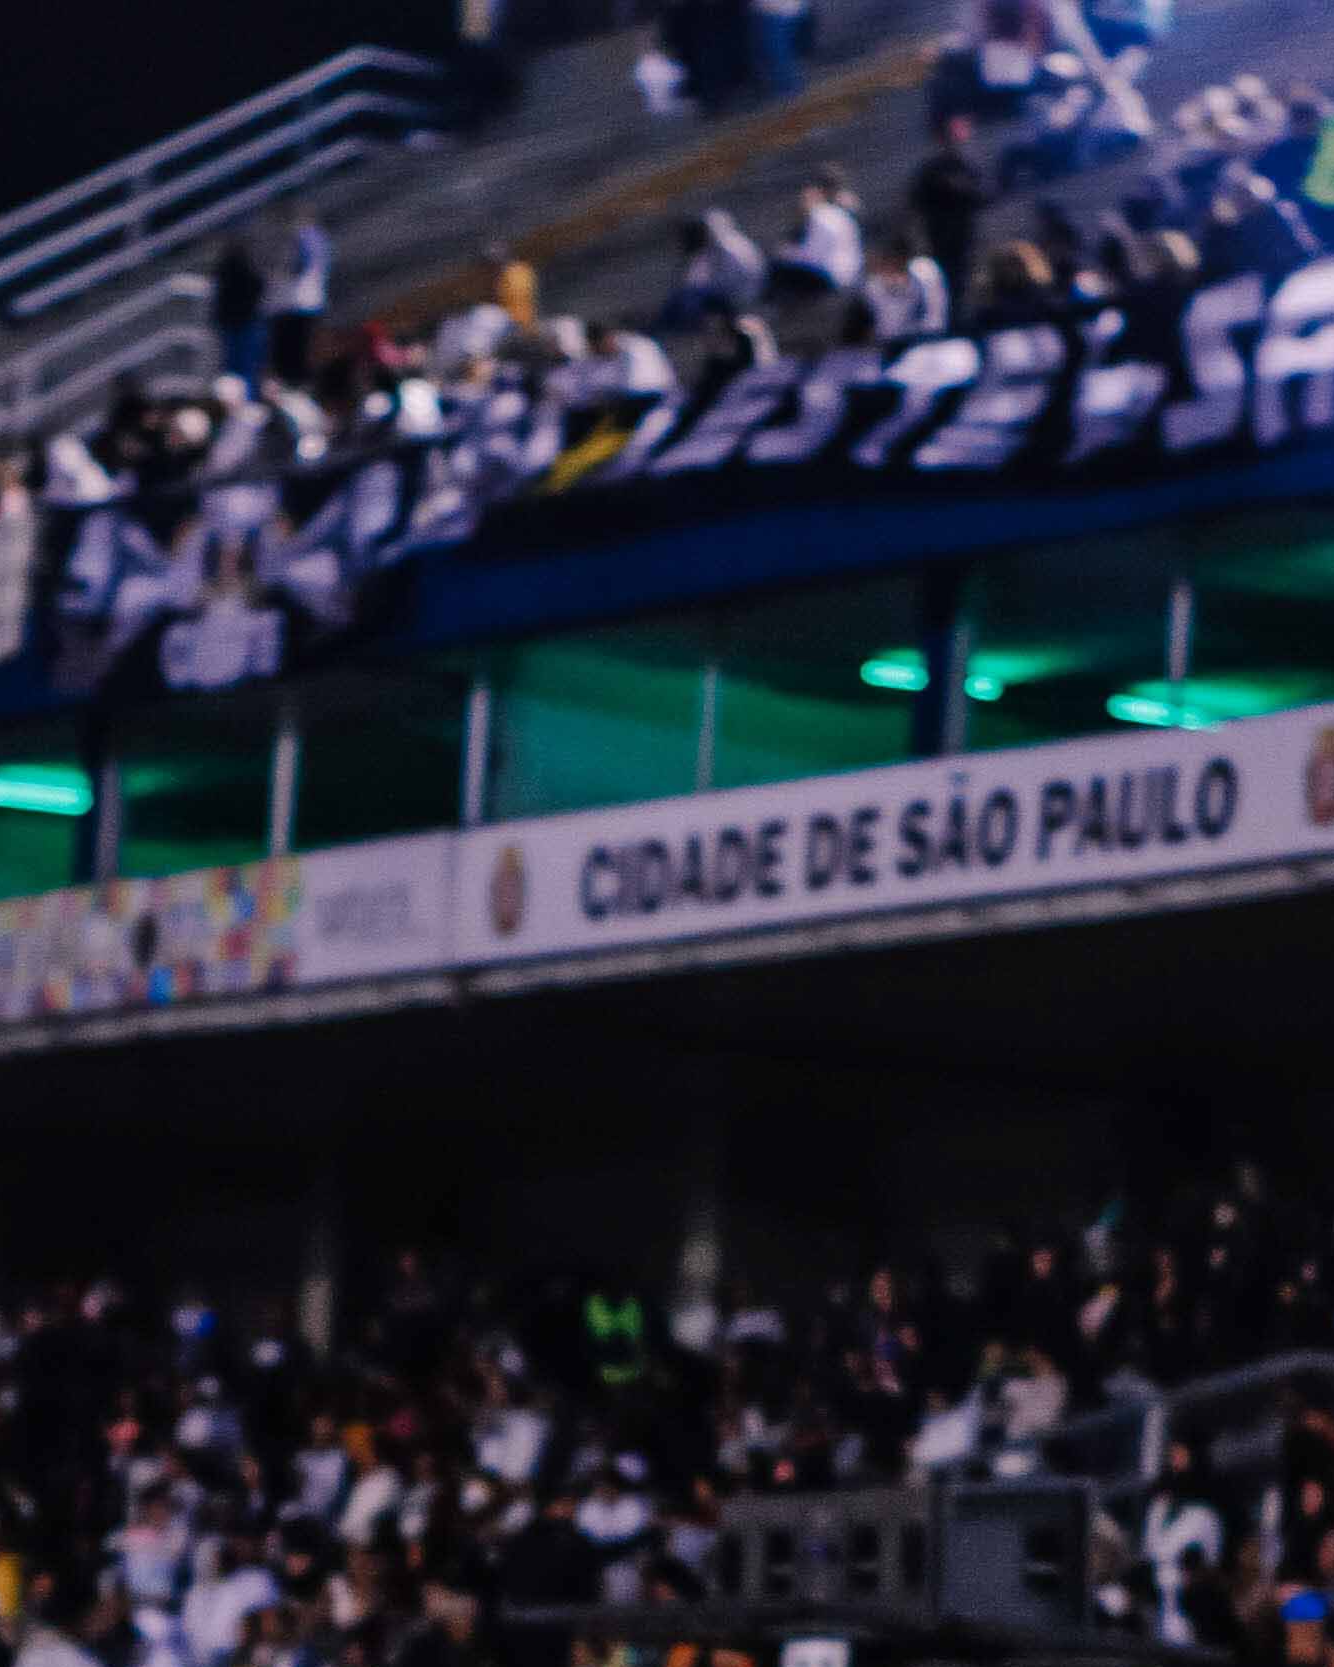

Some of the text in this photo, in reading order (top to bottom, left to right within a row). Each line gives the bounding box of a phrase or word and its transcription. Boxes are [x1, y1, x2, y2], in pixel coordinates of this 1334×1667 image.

[579, 755, 1240, 921] CIDADE DE SÃO PAULO
